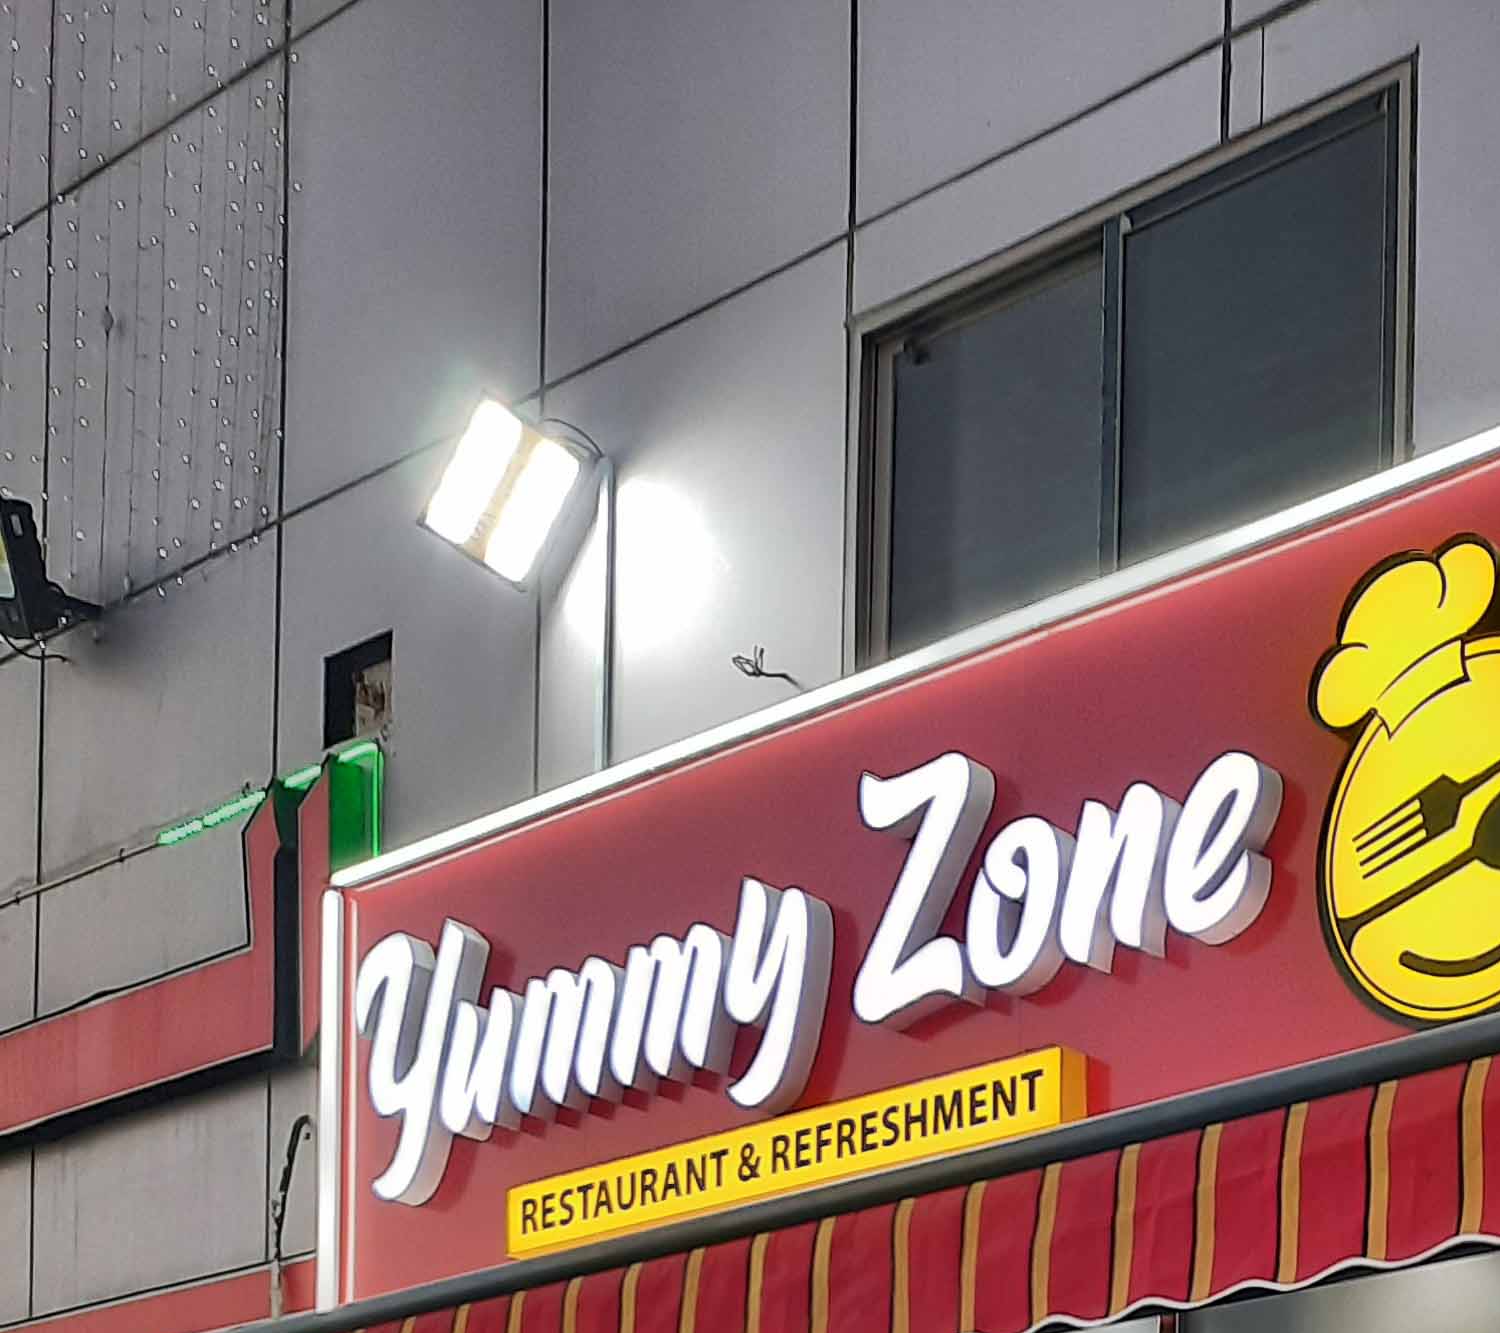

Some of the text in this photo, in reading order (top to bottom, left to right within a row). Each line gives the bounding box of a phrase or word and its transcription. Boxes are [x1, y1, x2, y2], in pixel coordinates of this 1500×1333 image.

[356, 751, 1281, 1206] Yummy Zone
[520, 1068, 1045, 1236] RESTAURANT & REFRESHMENT
